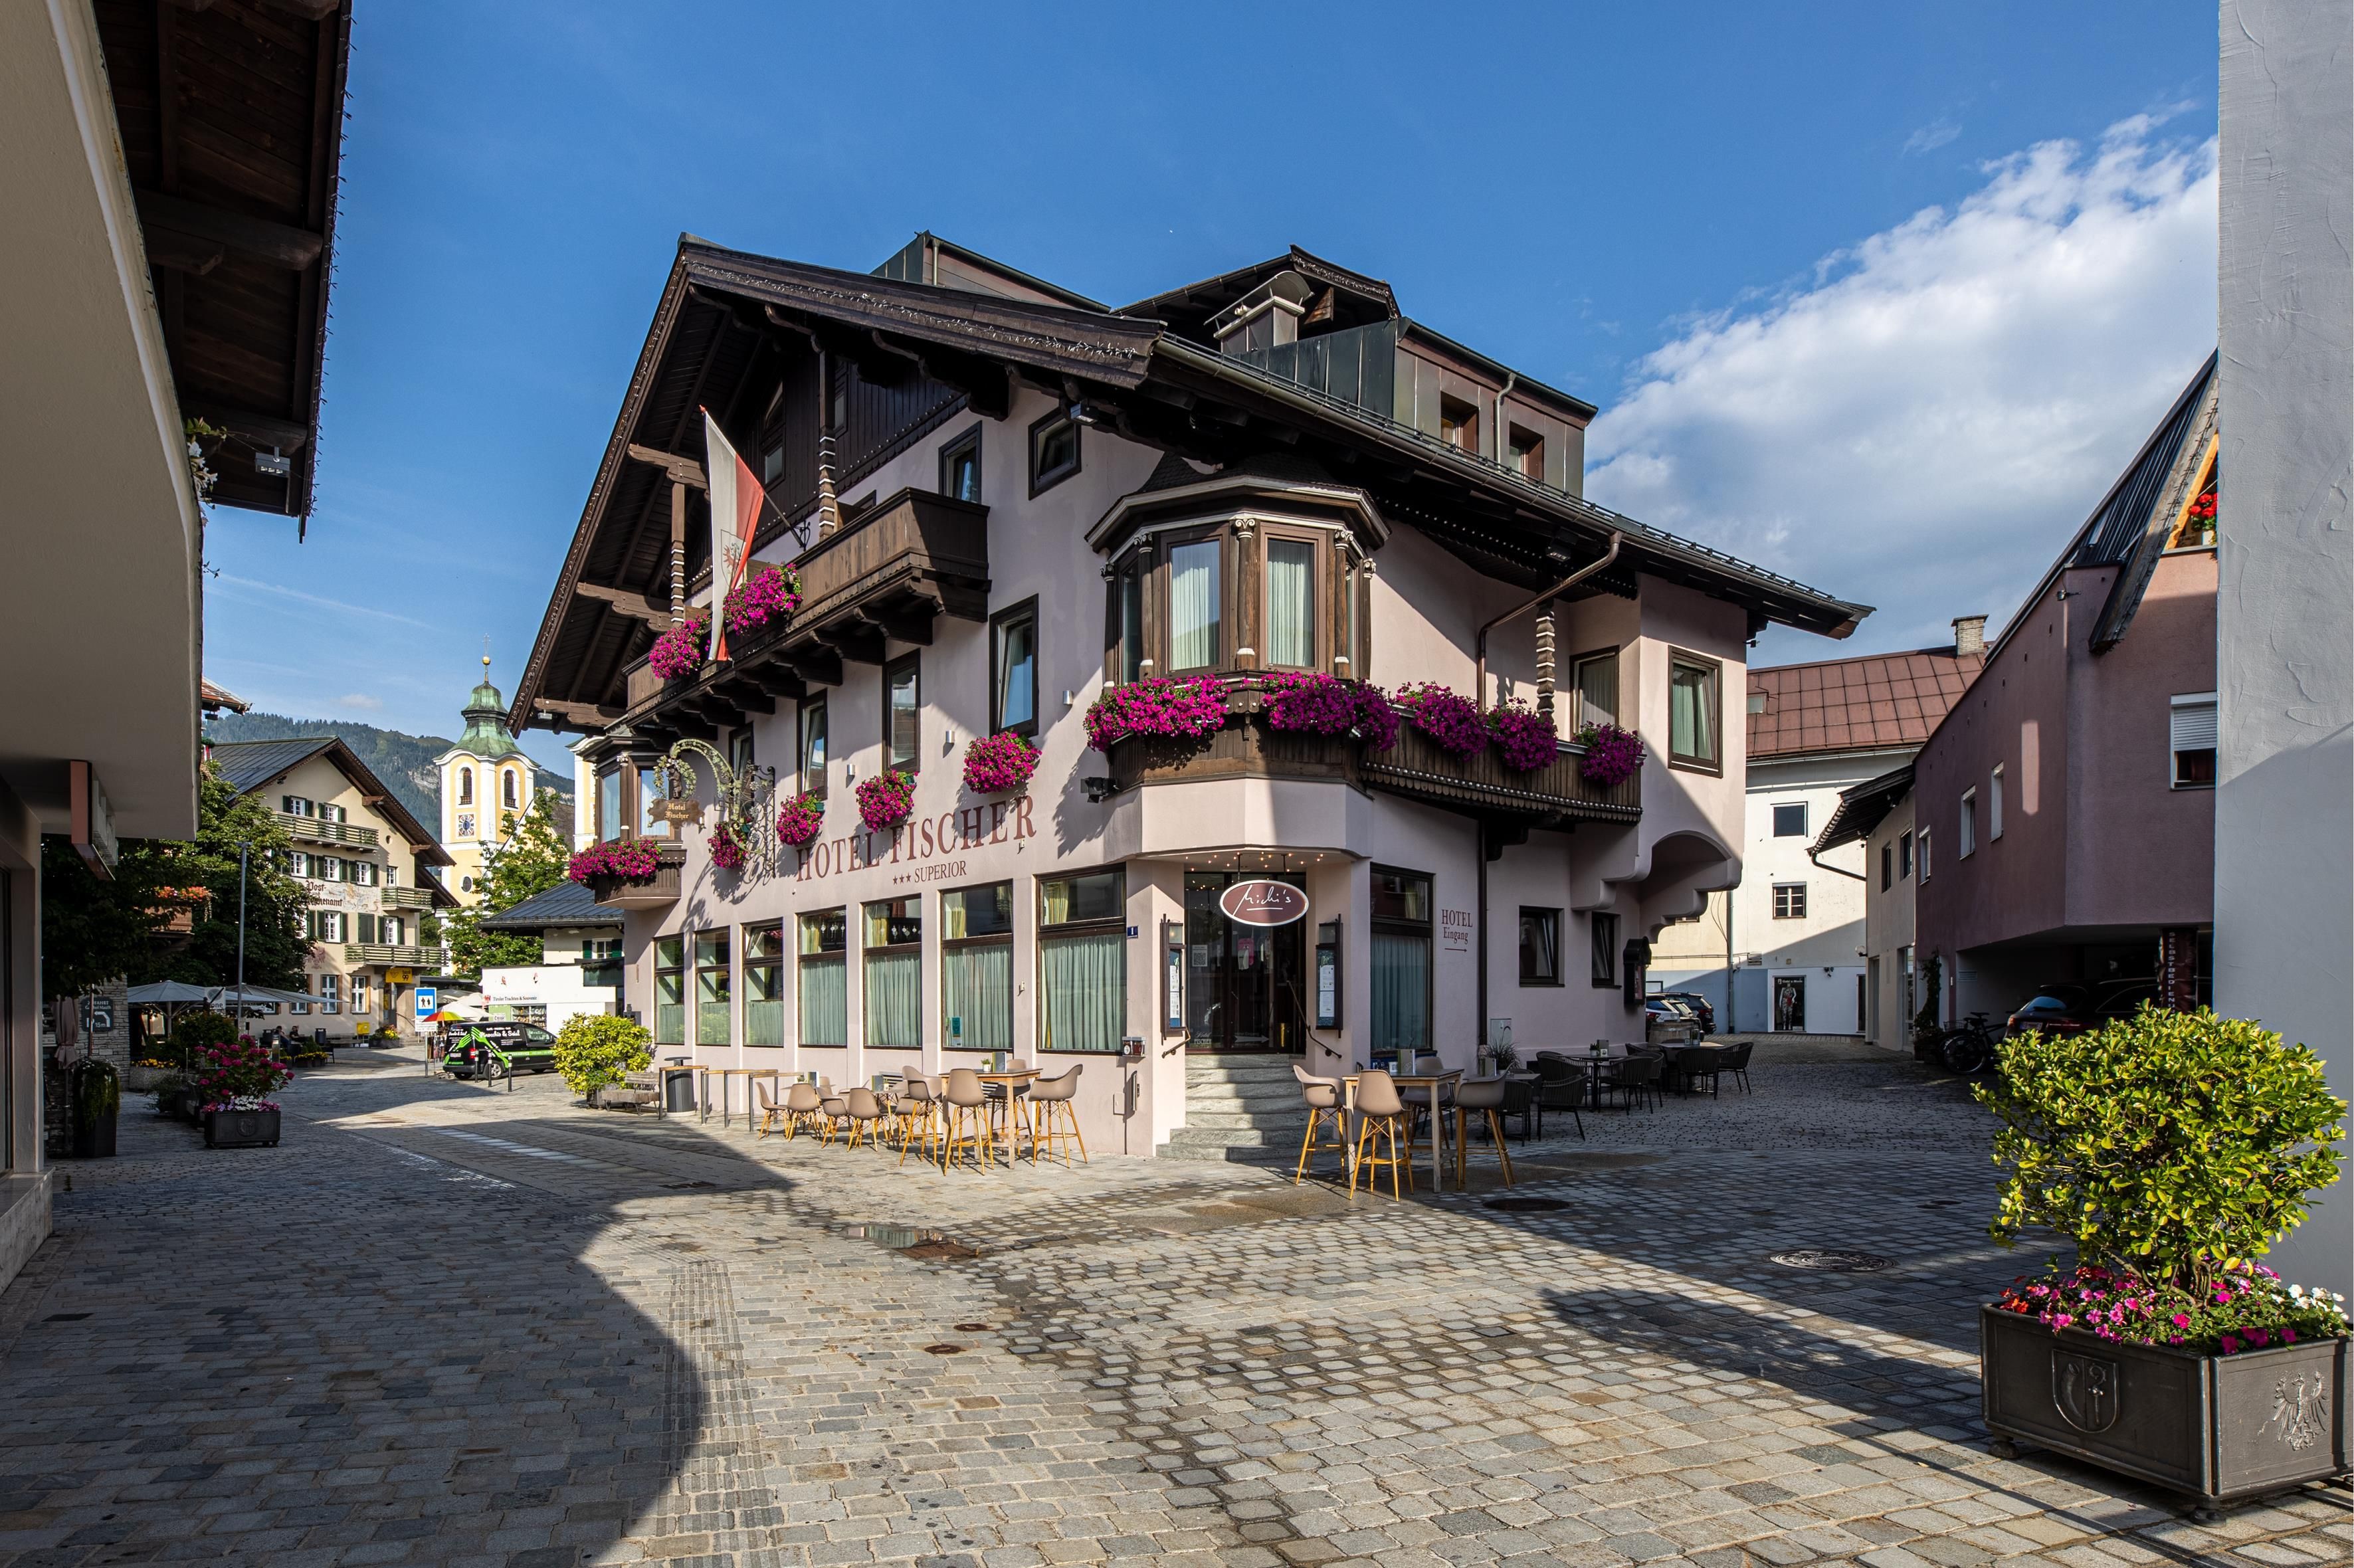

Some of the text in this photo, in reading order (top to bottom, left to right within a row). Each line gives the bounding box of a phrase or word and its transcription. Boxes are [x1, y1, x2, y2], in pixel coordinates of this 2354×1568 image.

[664, 811, 689, 820] Fischer
[666, 802, 686, 811] Hotel
[796, 795, 1037, 882] HOTEL FISCHER
[914, 860, 967, 883] SUPERIOR
[1441, 909, 1473, 928] HOTEL
[1443, 927, 1469, 945] Eingang
